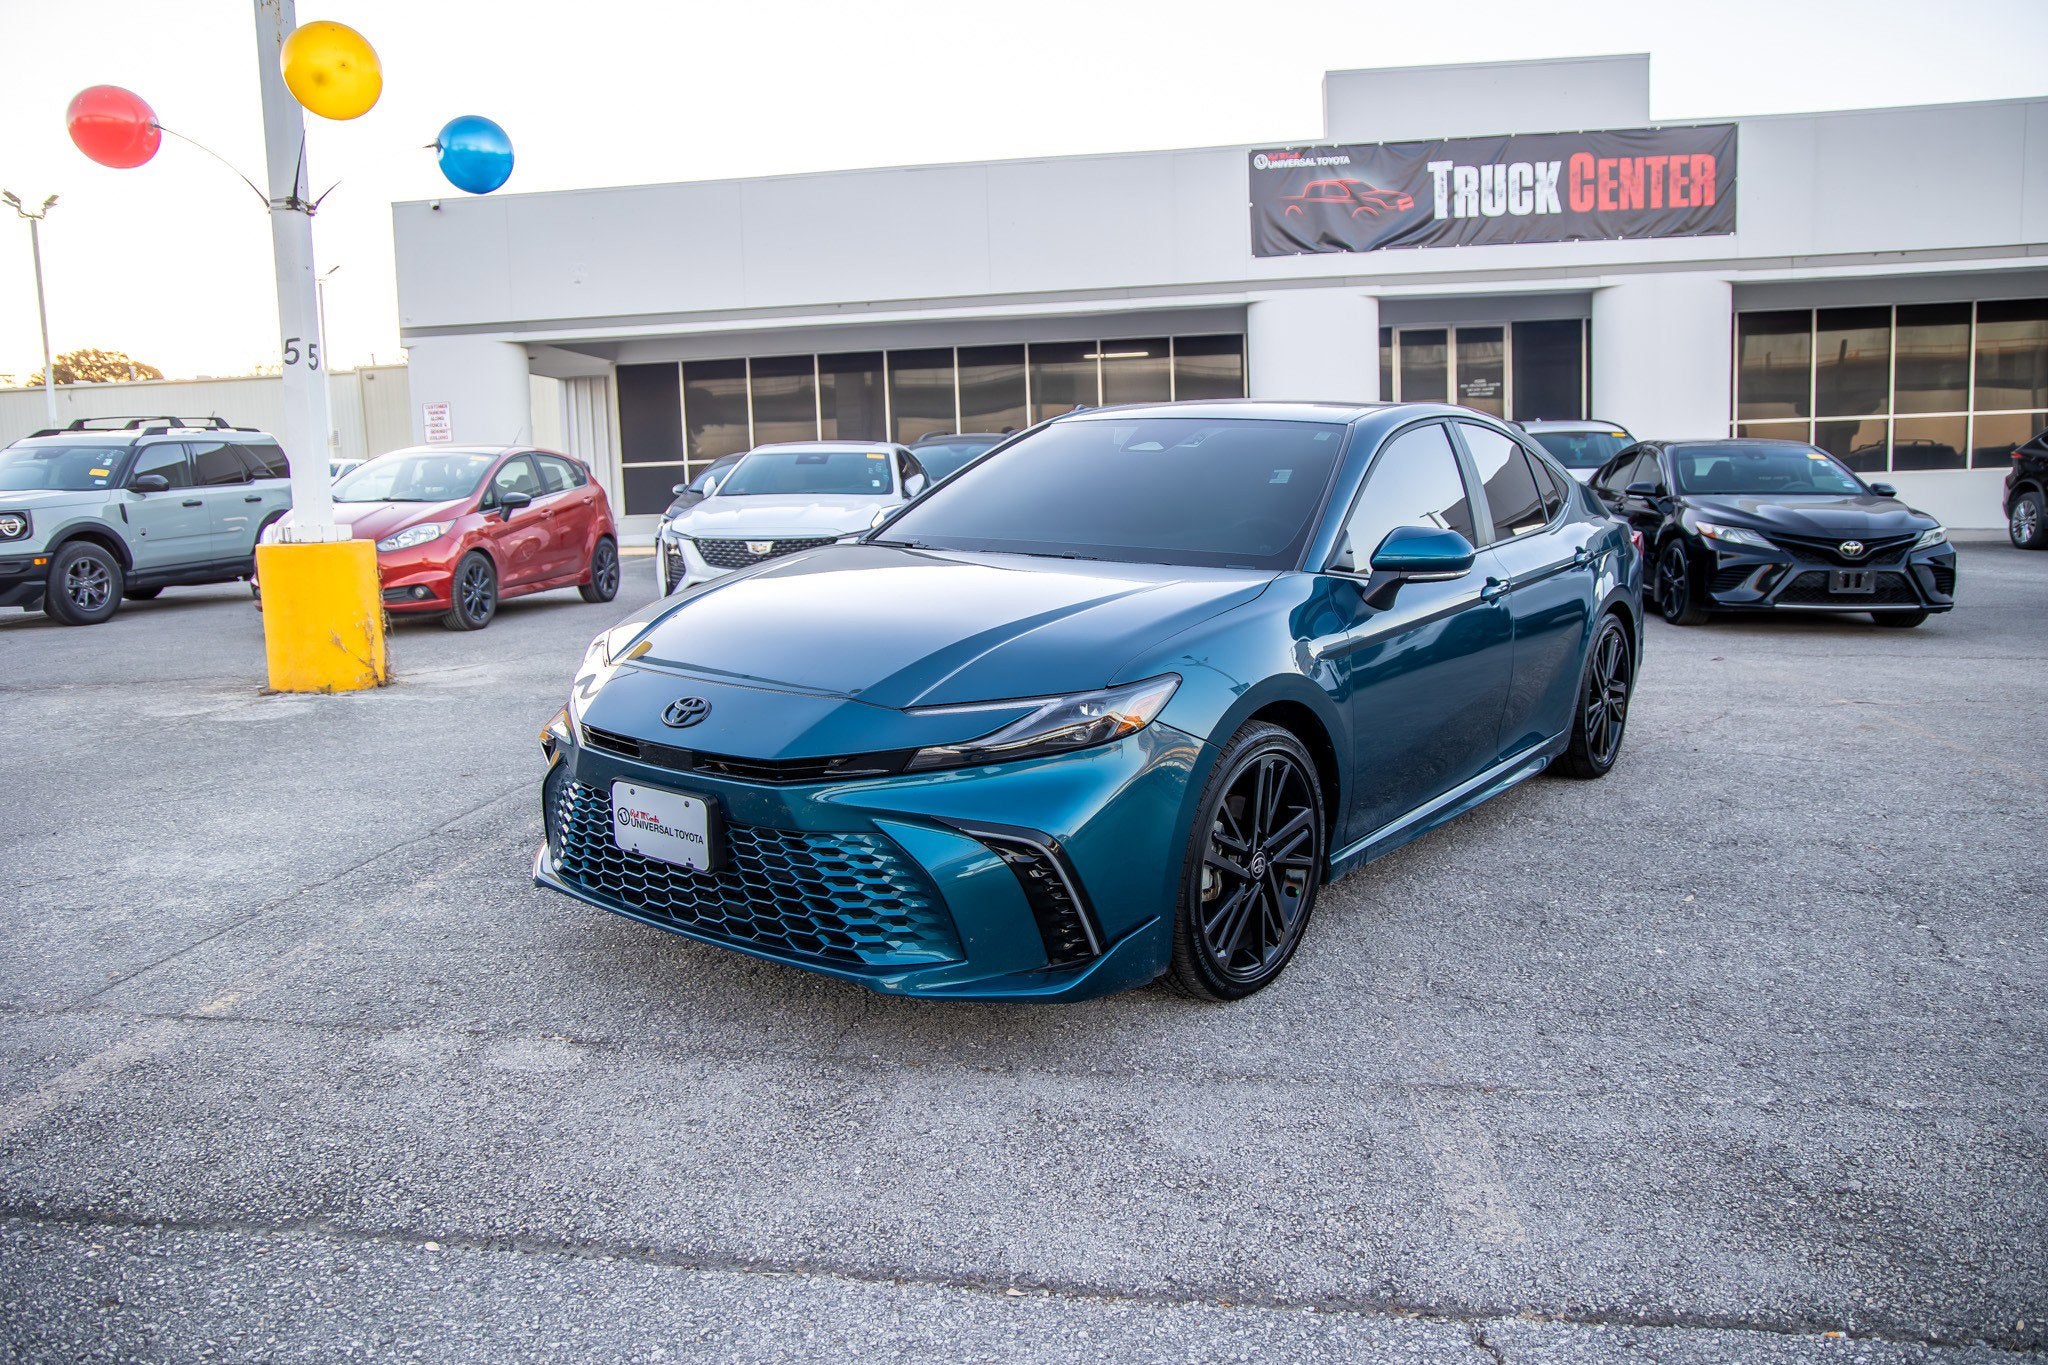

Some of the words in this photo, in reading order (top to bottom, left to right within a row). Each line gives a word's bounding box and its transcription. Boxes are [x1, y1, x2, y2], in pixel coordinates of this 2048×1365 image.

[1268, 157, 1317, 169] UNIVERSAL
[1317, 155, 1351, 166] TOYOTA
[1427, 159, 1562, 220] TRUCK
[1568, 151, 1716, 213] CENTER
[631, 818, 674, 836] UNIVERSAL
[673, 828, 704, 845] TOYOTA
